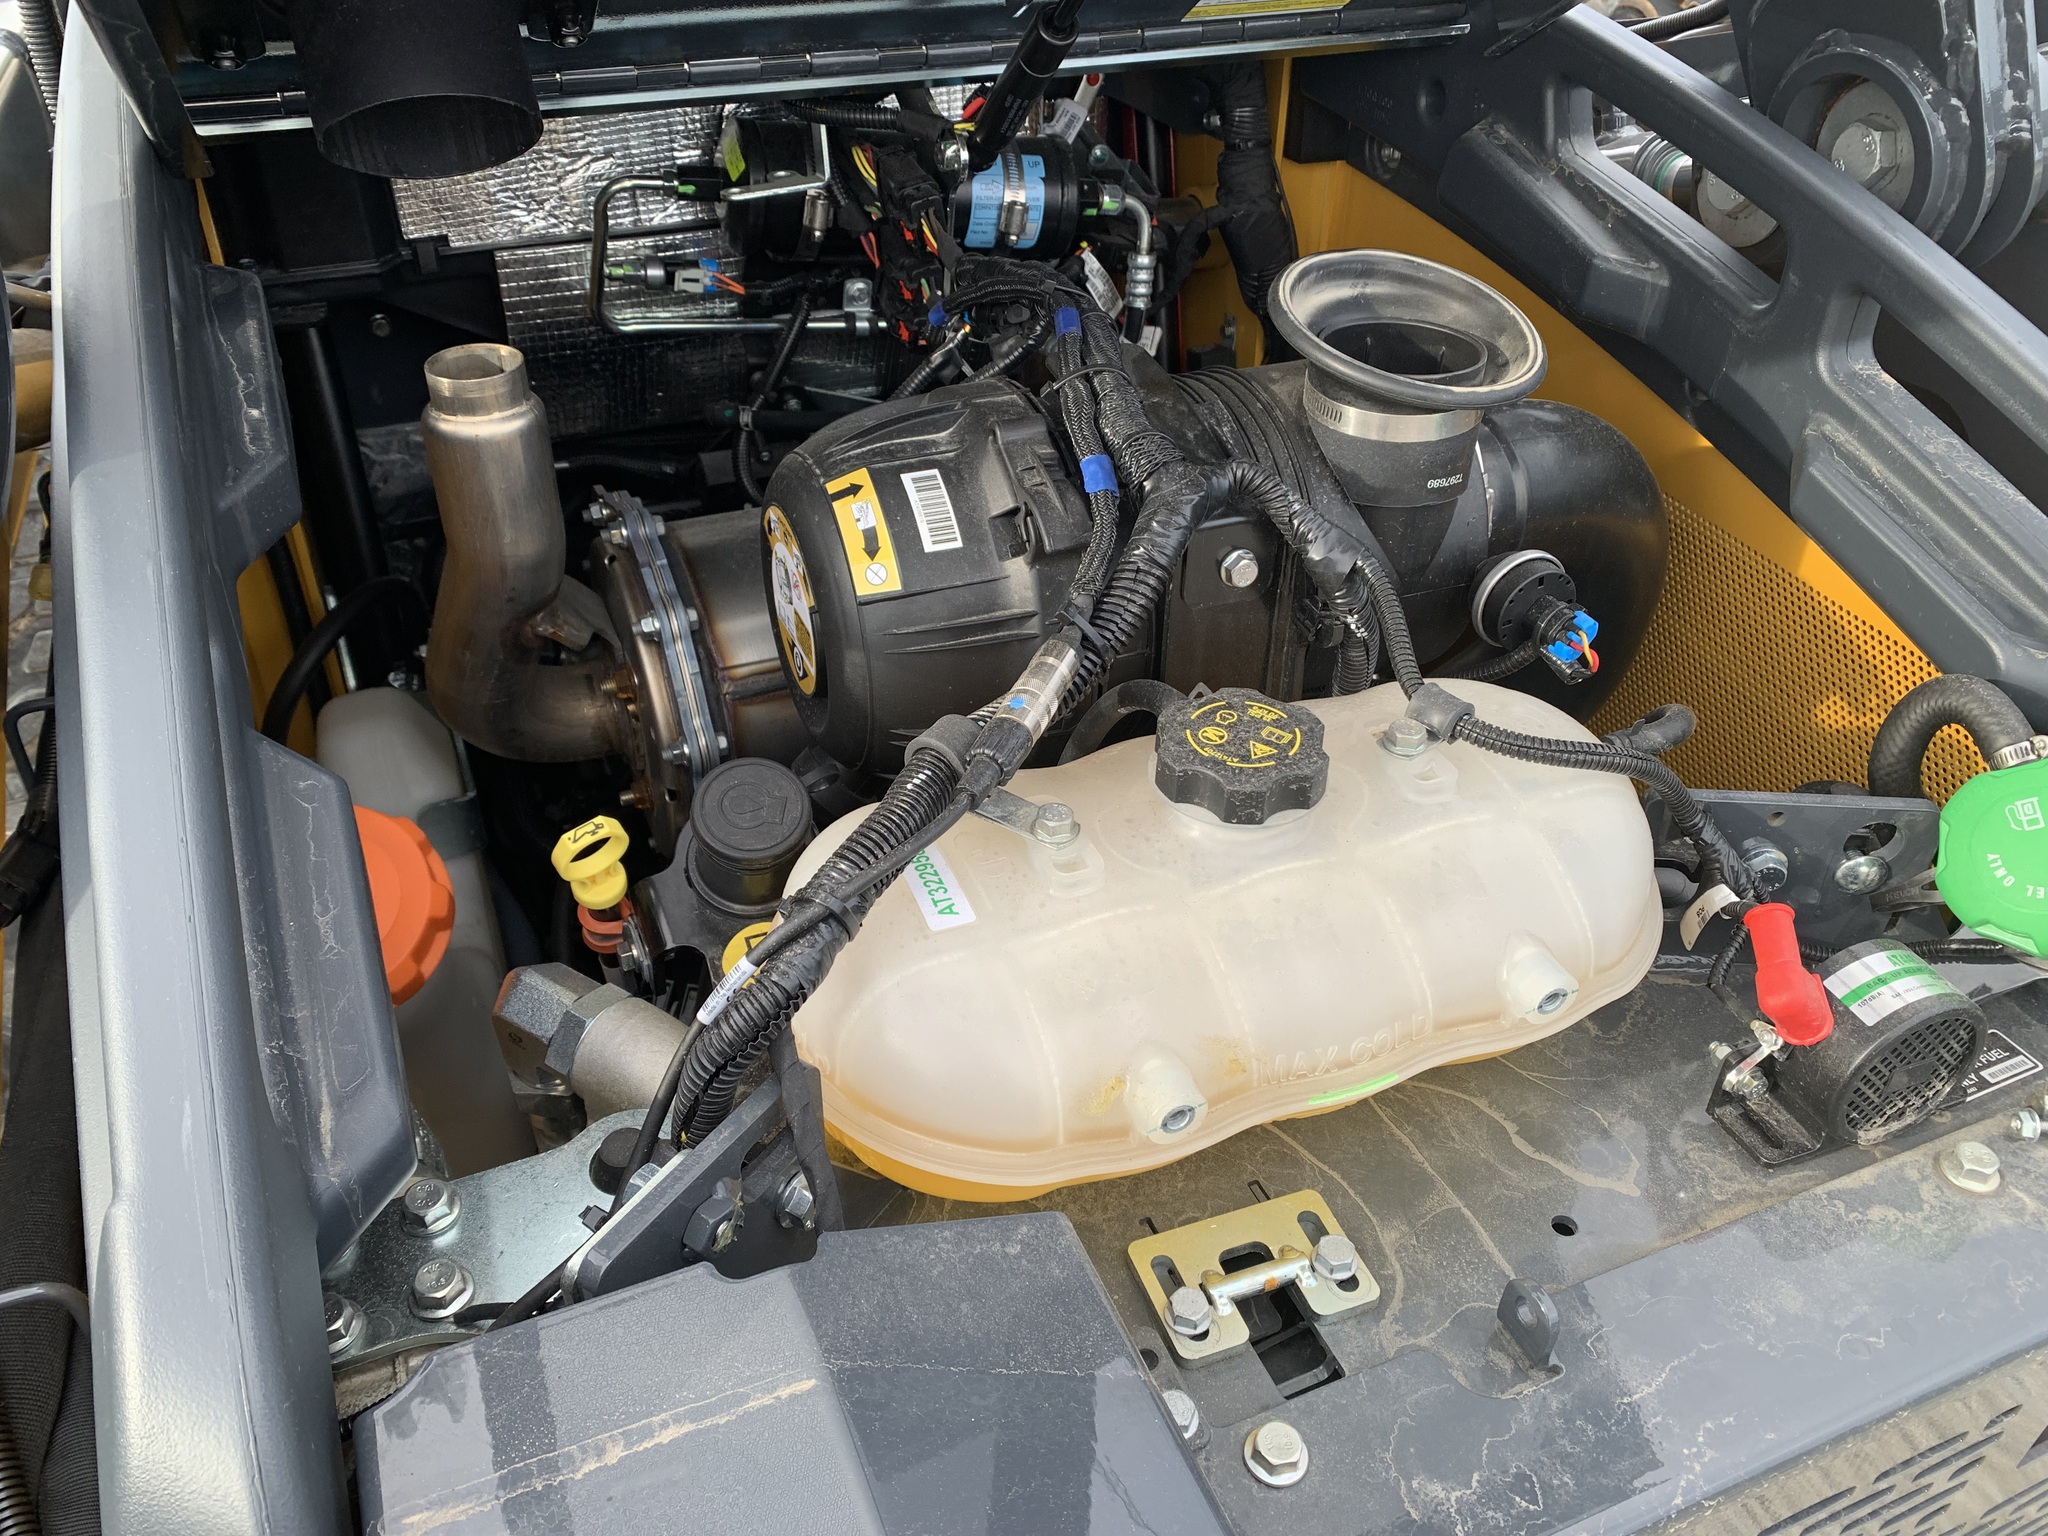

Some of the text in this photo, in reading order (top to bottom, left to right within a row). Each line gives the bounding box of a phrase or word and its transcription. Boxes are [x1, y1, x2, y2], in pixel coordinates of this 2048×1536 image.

[1027, 160, 1041, 169] UP
[1427, 473, 1463, 489] T297689
[1986, 852, 2048, 899] EL ONLY
[1257, 1013, 1432, 1087] MAX COLD
[1982, 1048, 2010, 1066] FUEL
[1962, 1070, 1979, 1088] NLY
